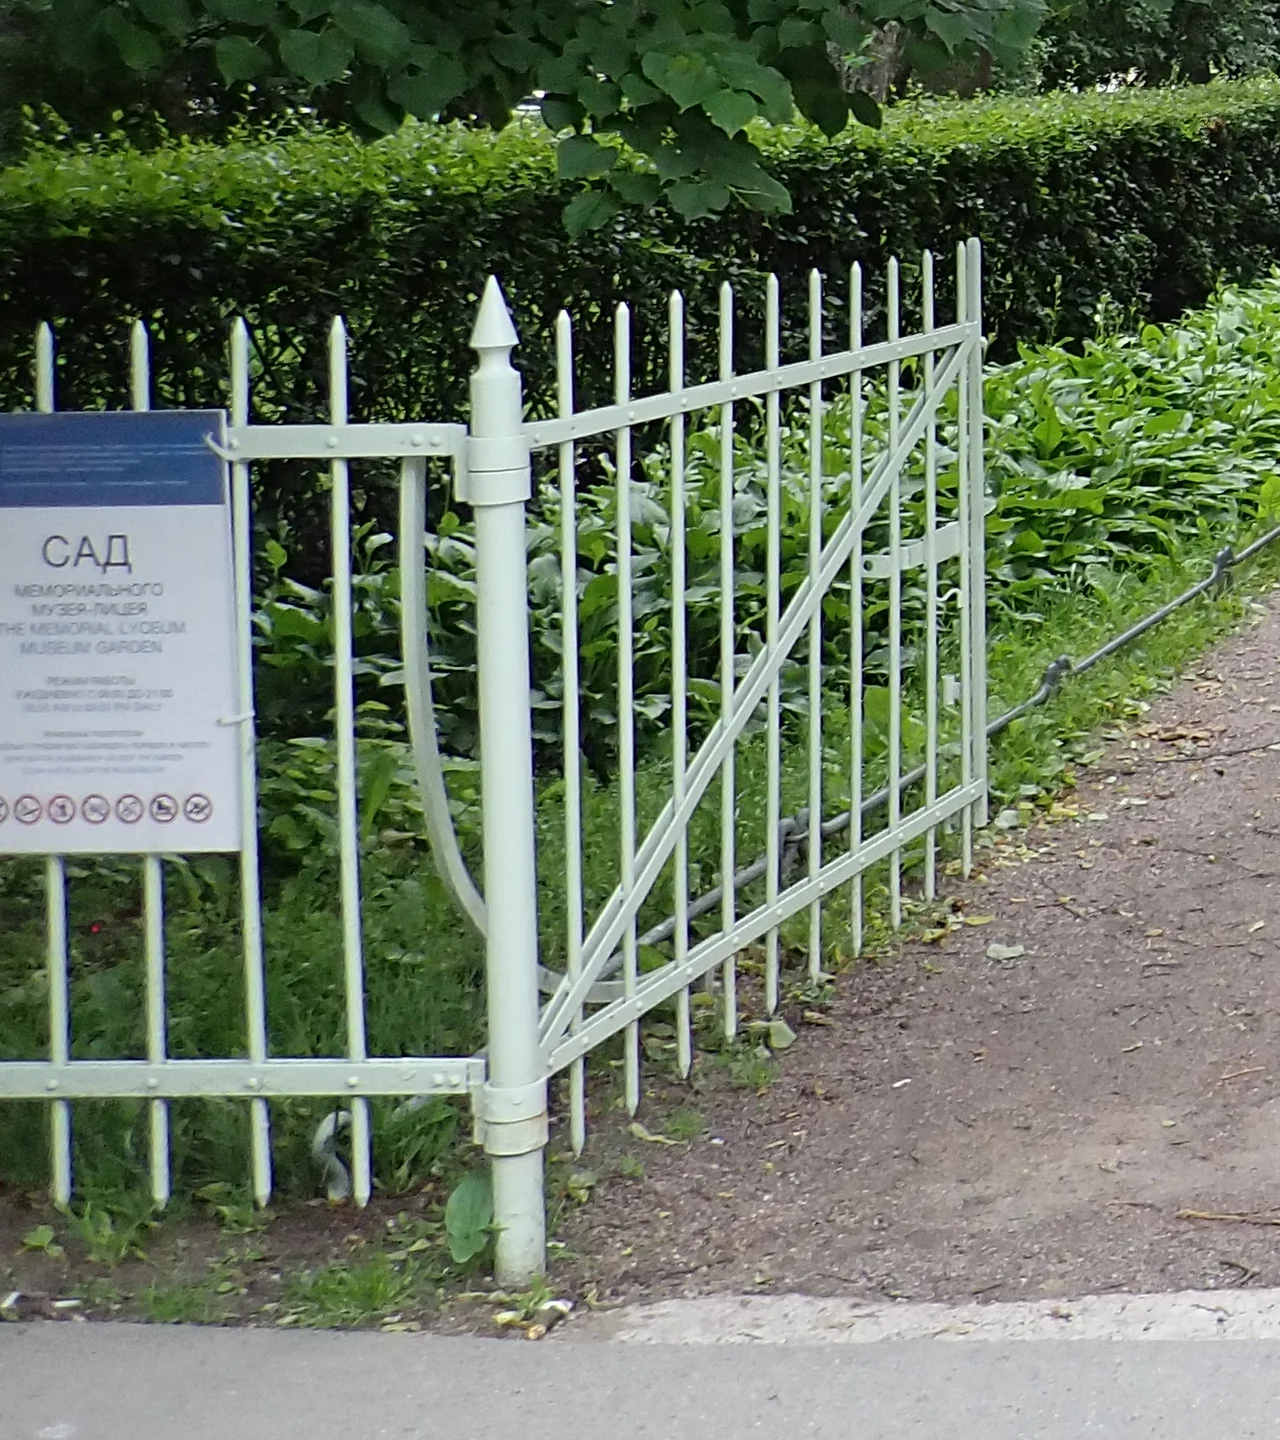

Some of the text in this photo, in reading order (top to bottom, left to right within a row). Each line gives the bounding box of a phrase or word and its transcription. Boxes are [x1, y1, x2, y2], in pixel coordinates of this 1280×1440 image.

[42, 535, 132, 574] САД
[14, 582, 164, 598] МЕМОРИАЛЬНОГО
[30, 622, 114, 635] MEMORIAL
[95, 639, 163, 654] GARDEN
